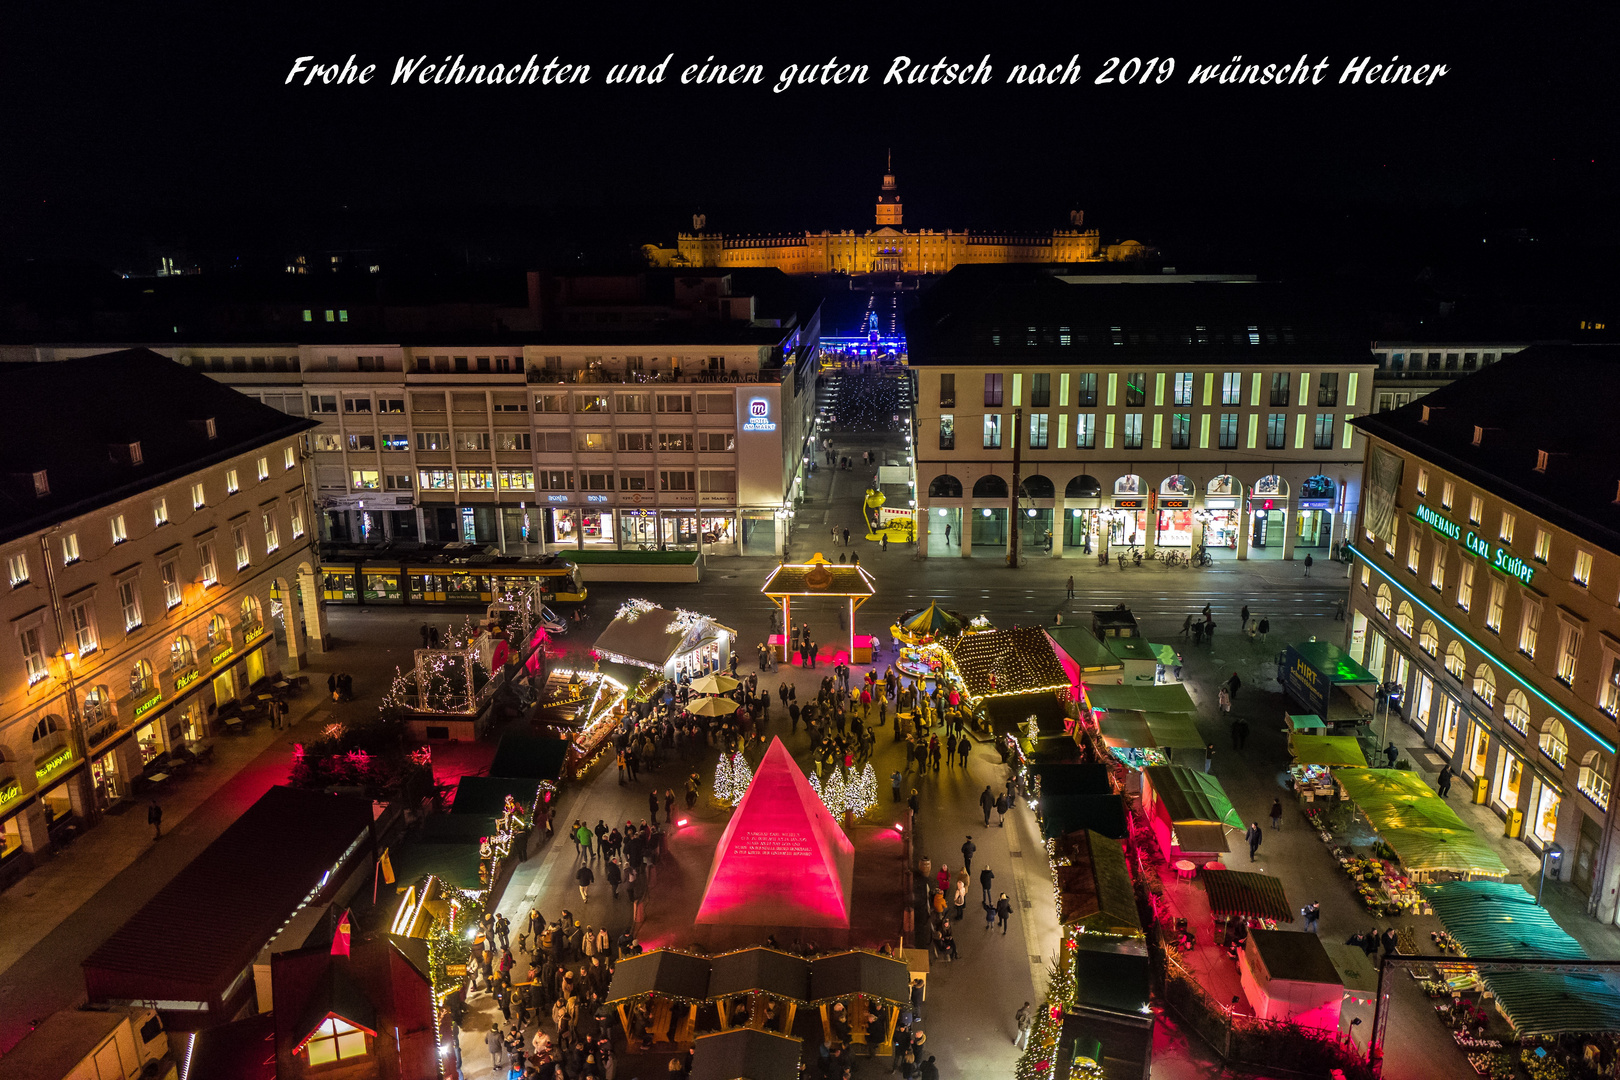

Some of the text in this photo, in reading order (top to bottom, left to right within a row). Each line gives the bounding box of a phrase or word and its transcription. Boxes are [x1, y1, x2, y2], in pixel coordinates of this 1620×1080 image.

[696, 375, 759, 383] WILLKOMMEN
[744, 423, 776, 431] AM MARKT
[1416, 503, 1534, 584] MODEHAUS CARL SCHÖPF
[1297, 658, 1318, 685] HIRT
[35, 749, 71, 779] RESTAURANT
